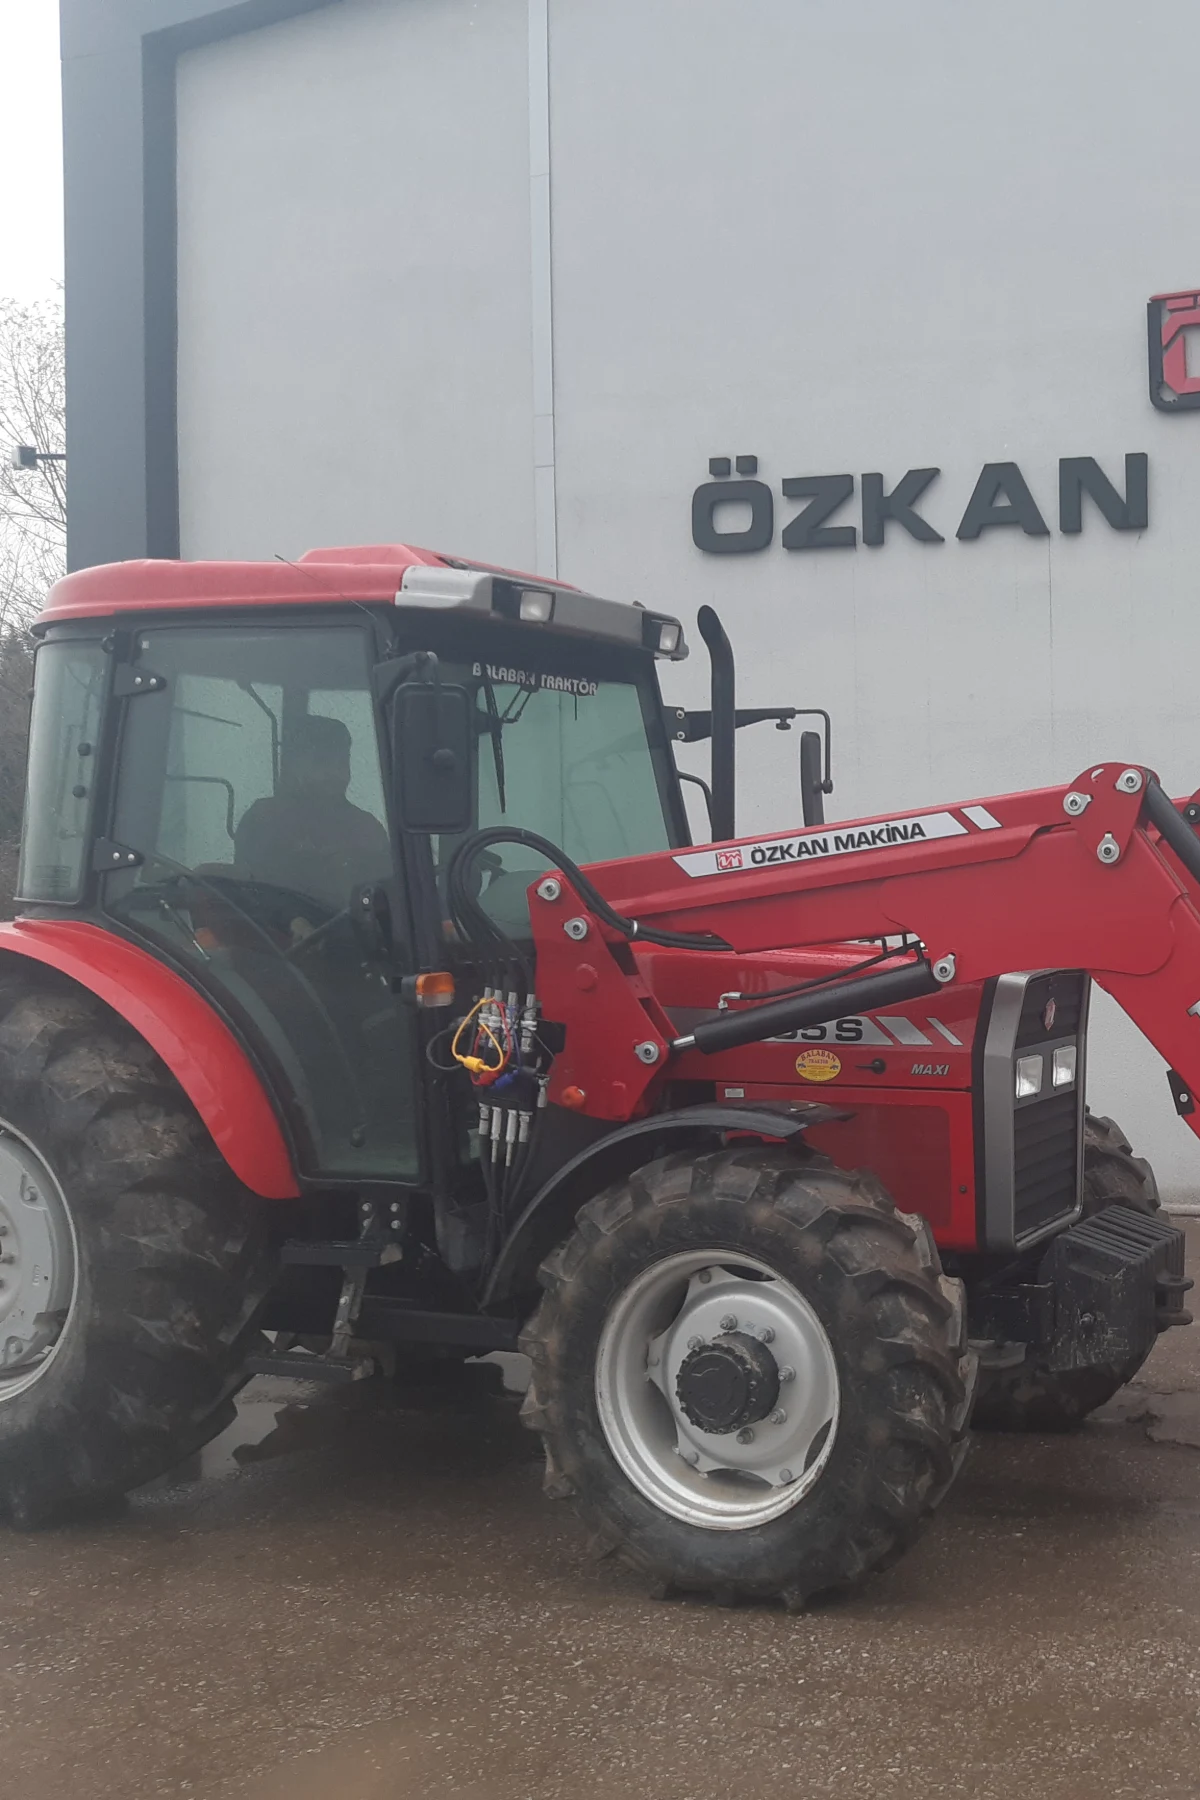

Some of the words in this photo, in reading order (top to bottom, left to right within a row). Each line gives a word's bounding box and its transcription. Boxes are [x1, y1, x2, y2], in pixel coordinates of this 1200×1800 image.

[692, 452, 1148, 553] ÖZKAN
[540, 674, 598, 696] TRAKTÖR
[750, 837, 829, 865] ÖZKAN
[835, 822, 926, 852] MAKİNA
[774, 1025, 827, 1041] 5
[835, 1018, 863, 1042] S
[800, 1050, 837, 1062] BALABAN
[911, 1063, 950, 1076] MAXI
